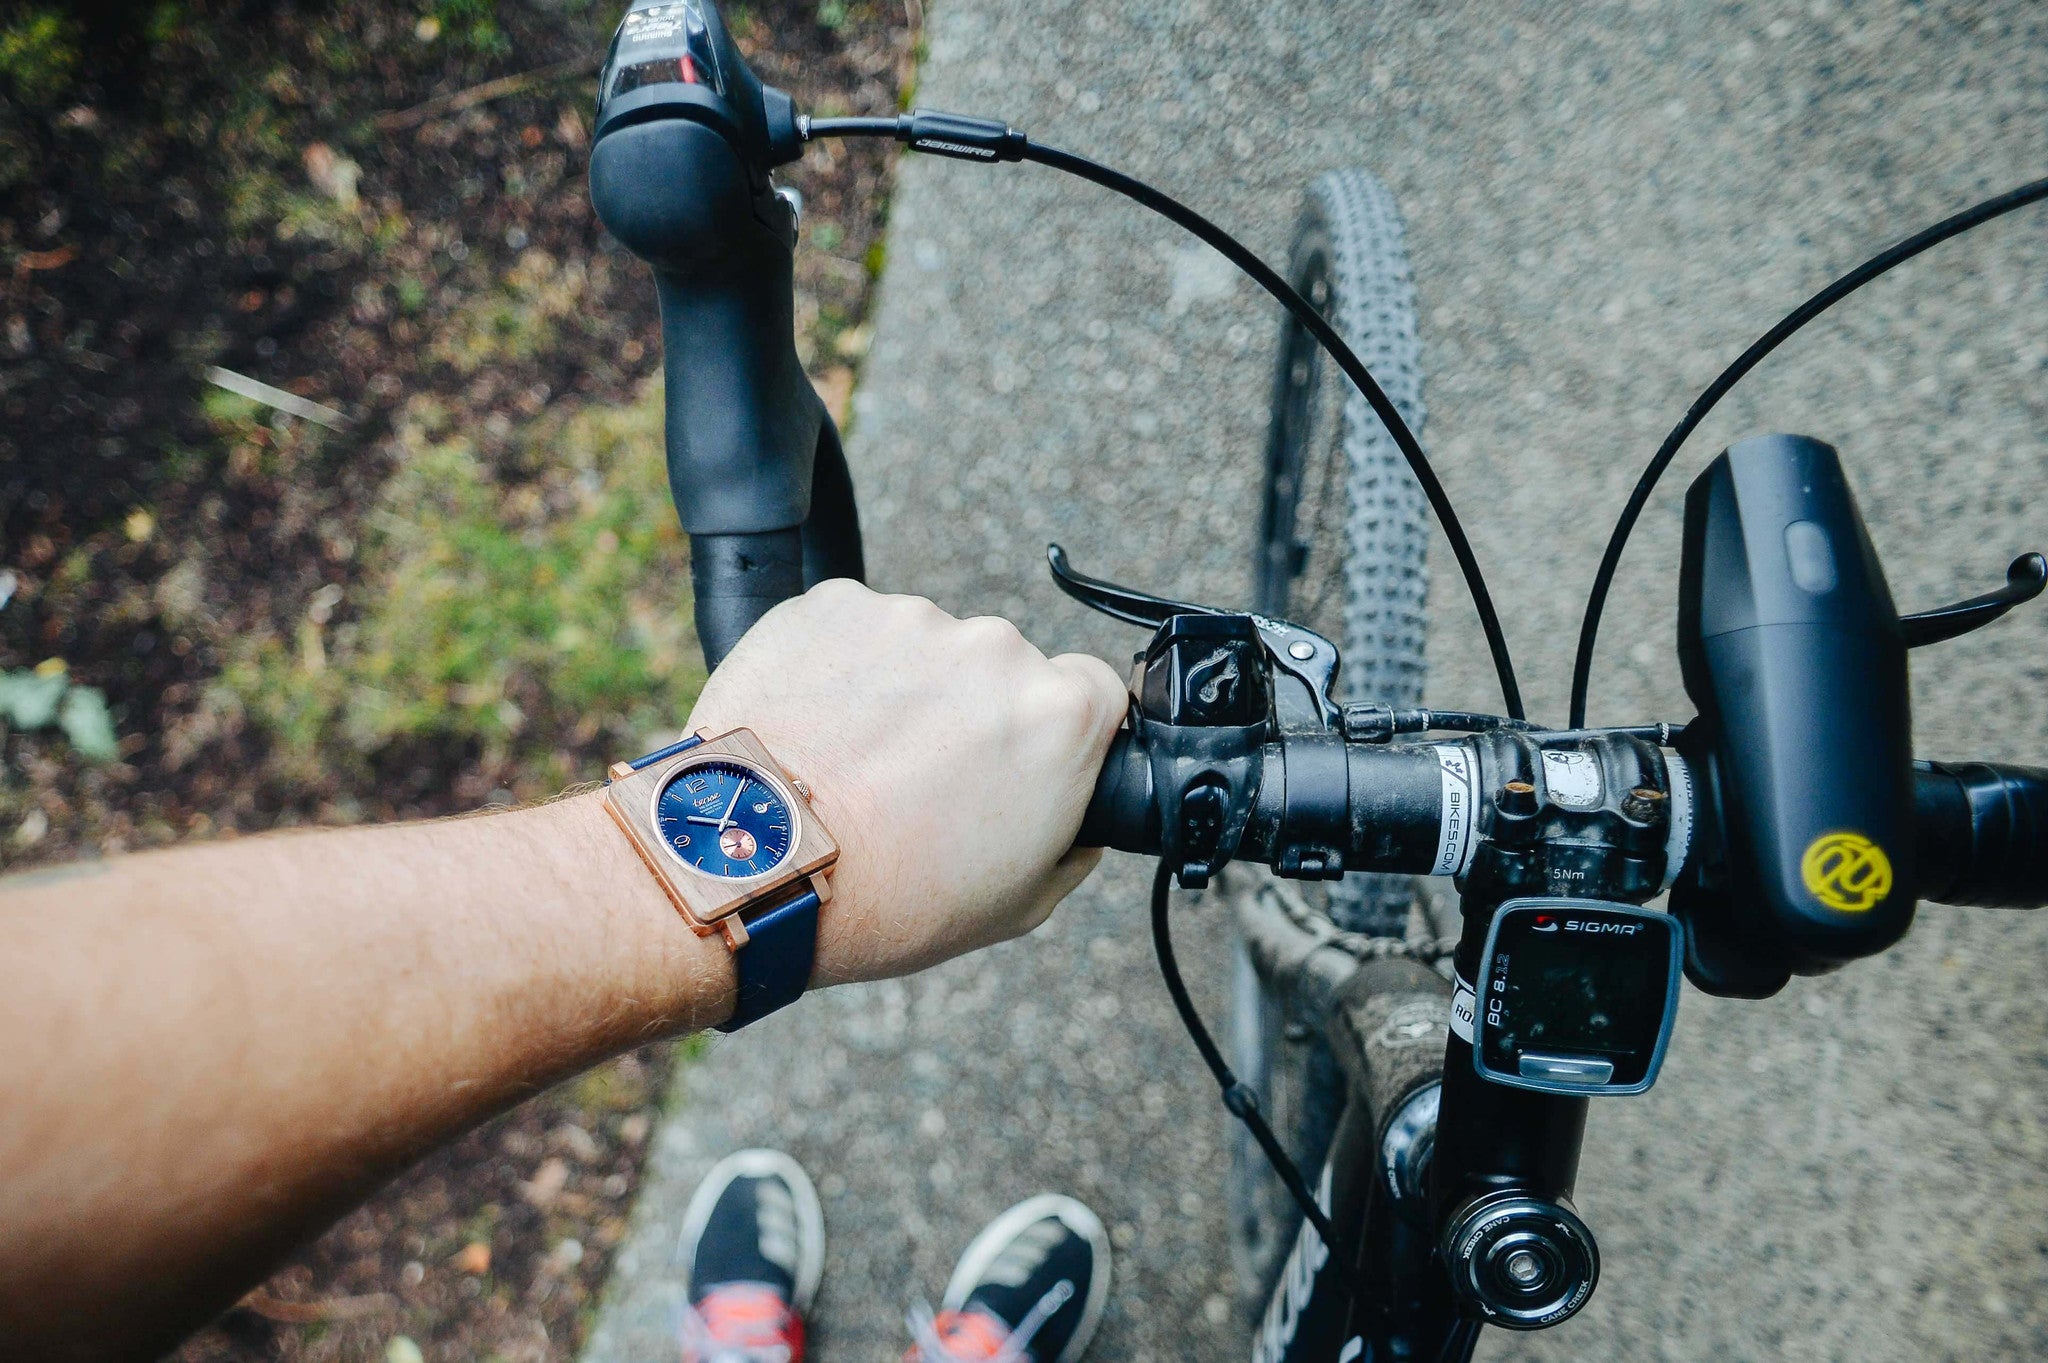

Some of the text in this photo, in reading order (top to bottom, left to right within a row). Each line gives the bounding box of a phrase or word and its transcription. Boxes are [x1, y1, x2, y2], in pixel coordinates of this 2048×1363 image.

[632, 30, 673, 42] SHIMANO
[685, 777, 709, 794] 12
[1440, 792, 1460, 870] BIKES.COM
[1564, 920, 1636, 935] SIGMA
[1487, 953, 1509, 1026] BC 8.12
[1462, 1216, 1510, 1259] CANE CREEK
[1540, 1280, 1589, 1323] CANE CREEK
